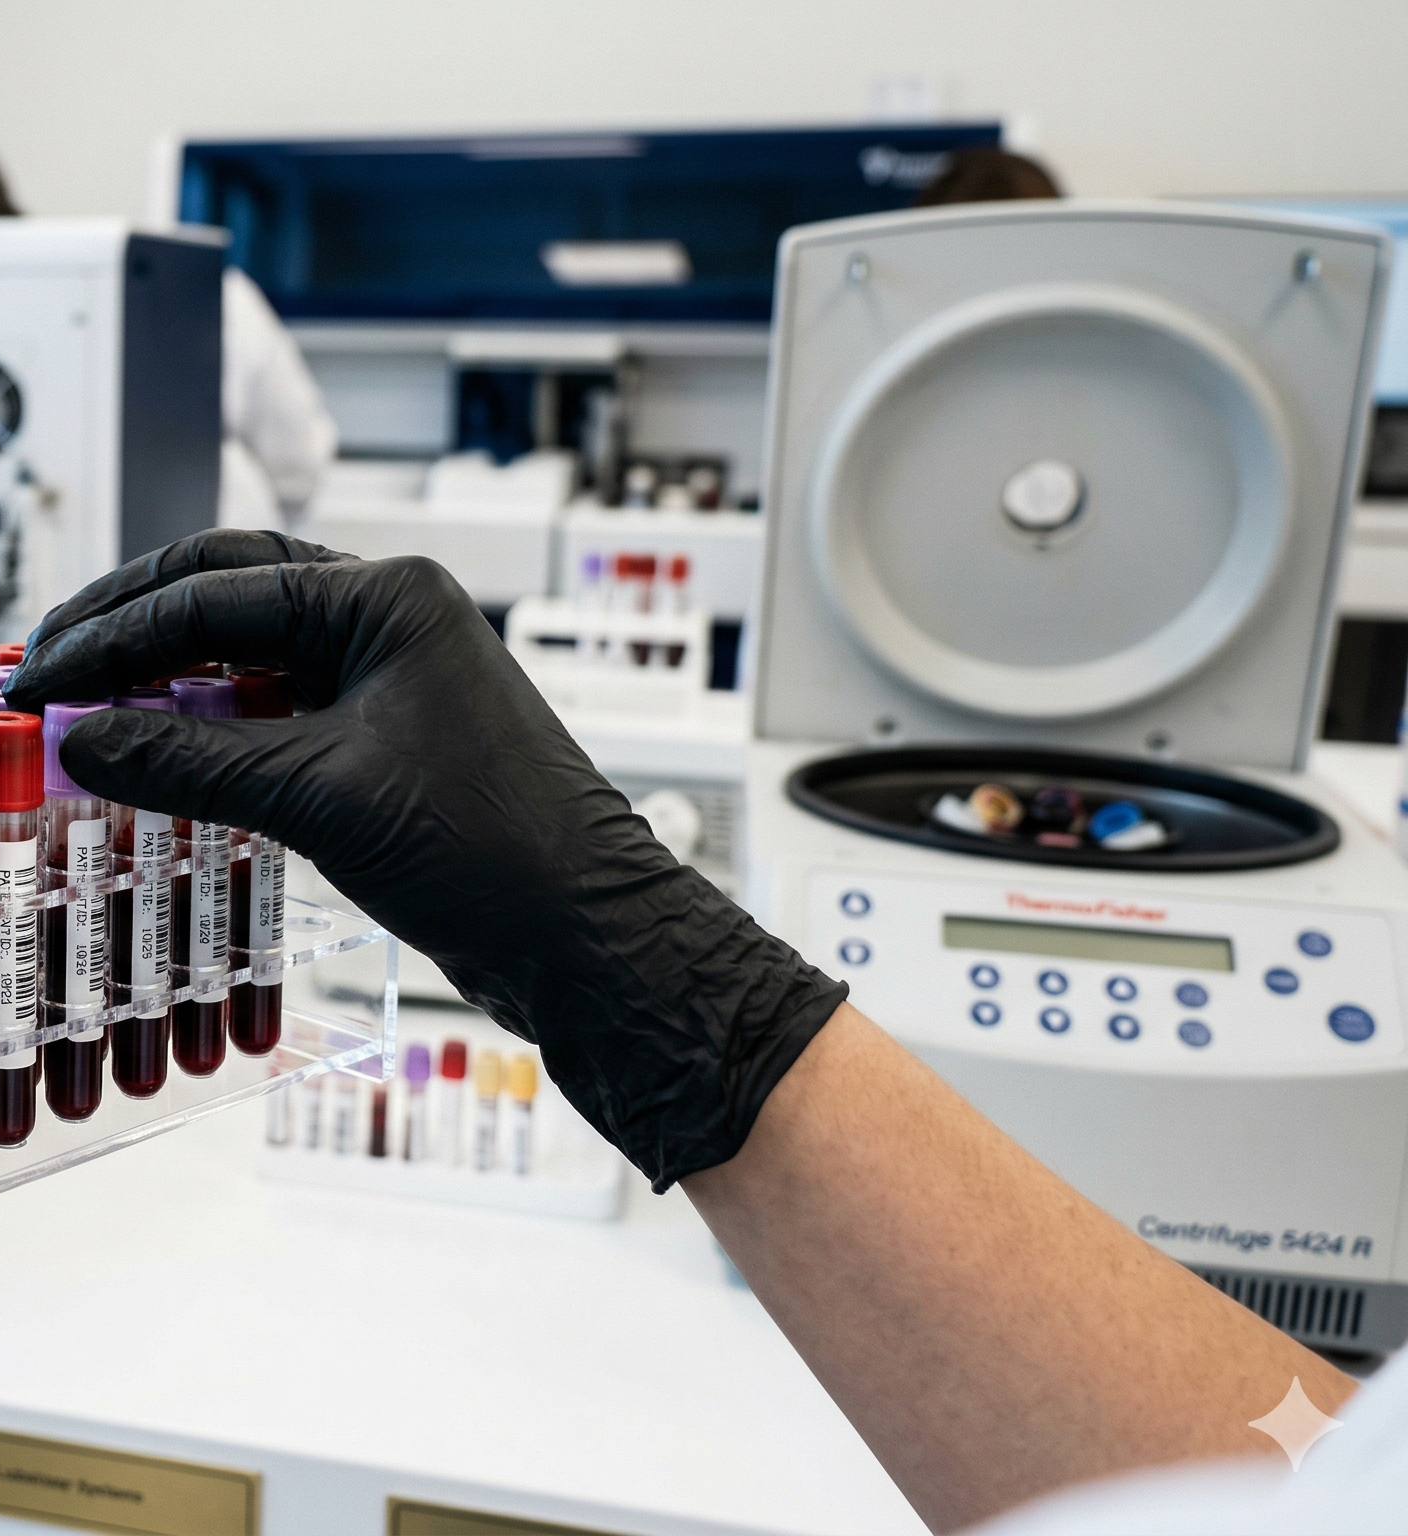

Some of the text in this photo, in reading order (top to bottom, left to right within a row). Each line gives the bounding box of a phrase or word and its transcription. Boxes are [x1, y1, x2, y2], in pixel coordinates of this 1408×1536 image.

[1138, 1214, 1374, 1258] Centrifuge 5424 R
